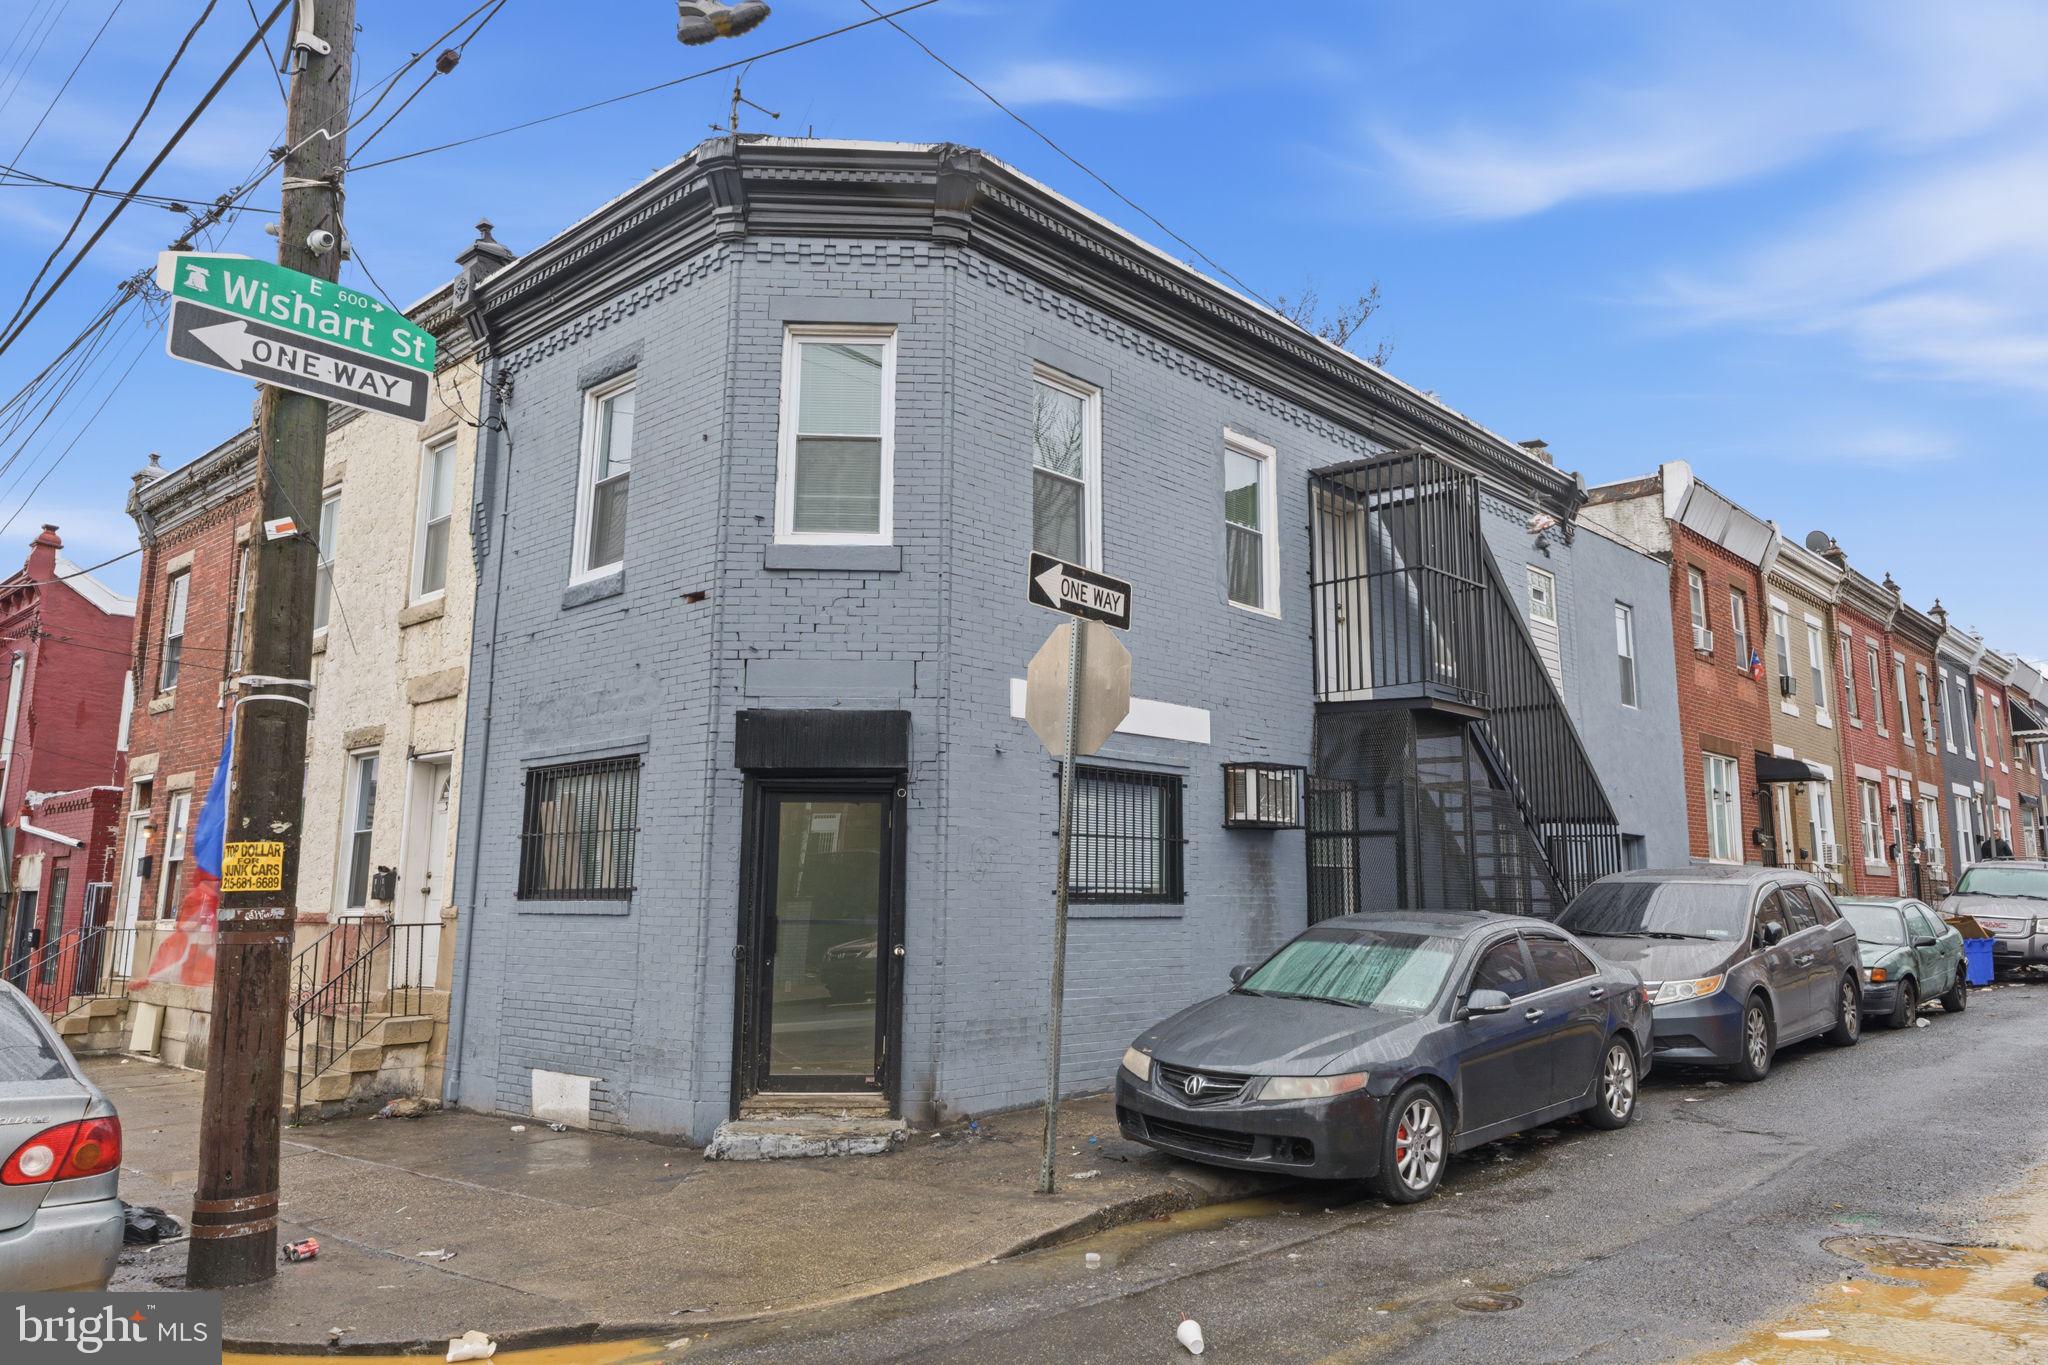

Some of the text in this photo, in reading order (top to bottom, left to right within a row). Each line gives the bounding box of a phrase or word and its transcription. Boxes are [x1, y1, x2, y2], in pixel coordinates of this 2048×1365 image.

[309, 278, 368, 309] E 600
[223, 270, 426, 364] Wishart St
[252, 340, 400, 399] ONE WAY
[1061, 578, 1120, 612] ONE WAY
[225, 843, 281, 858] TOP DOLLAR
[237, 857, 260, 865] FOR
[224, 863, 280, 877] JUNK CARS
